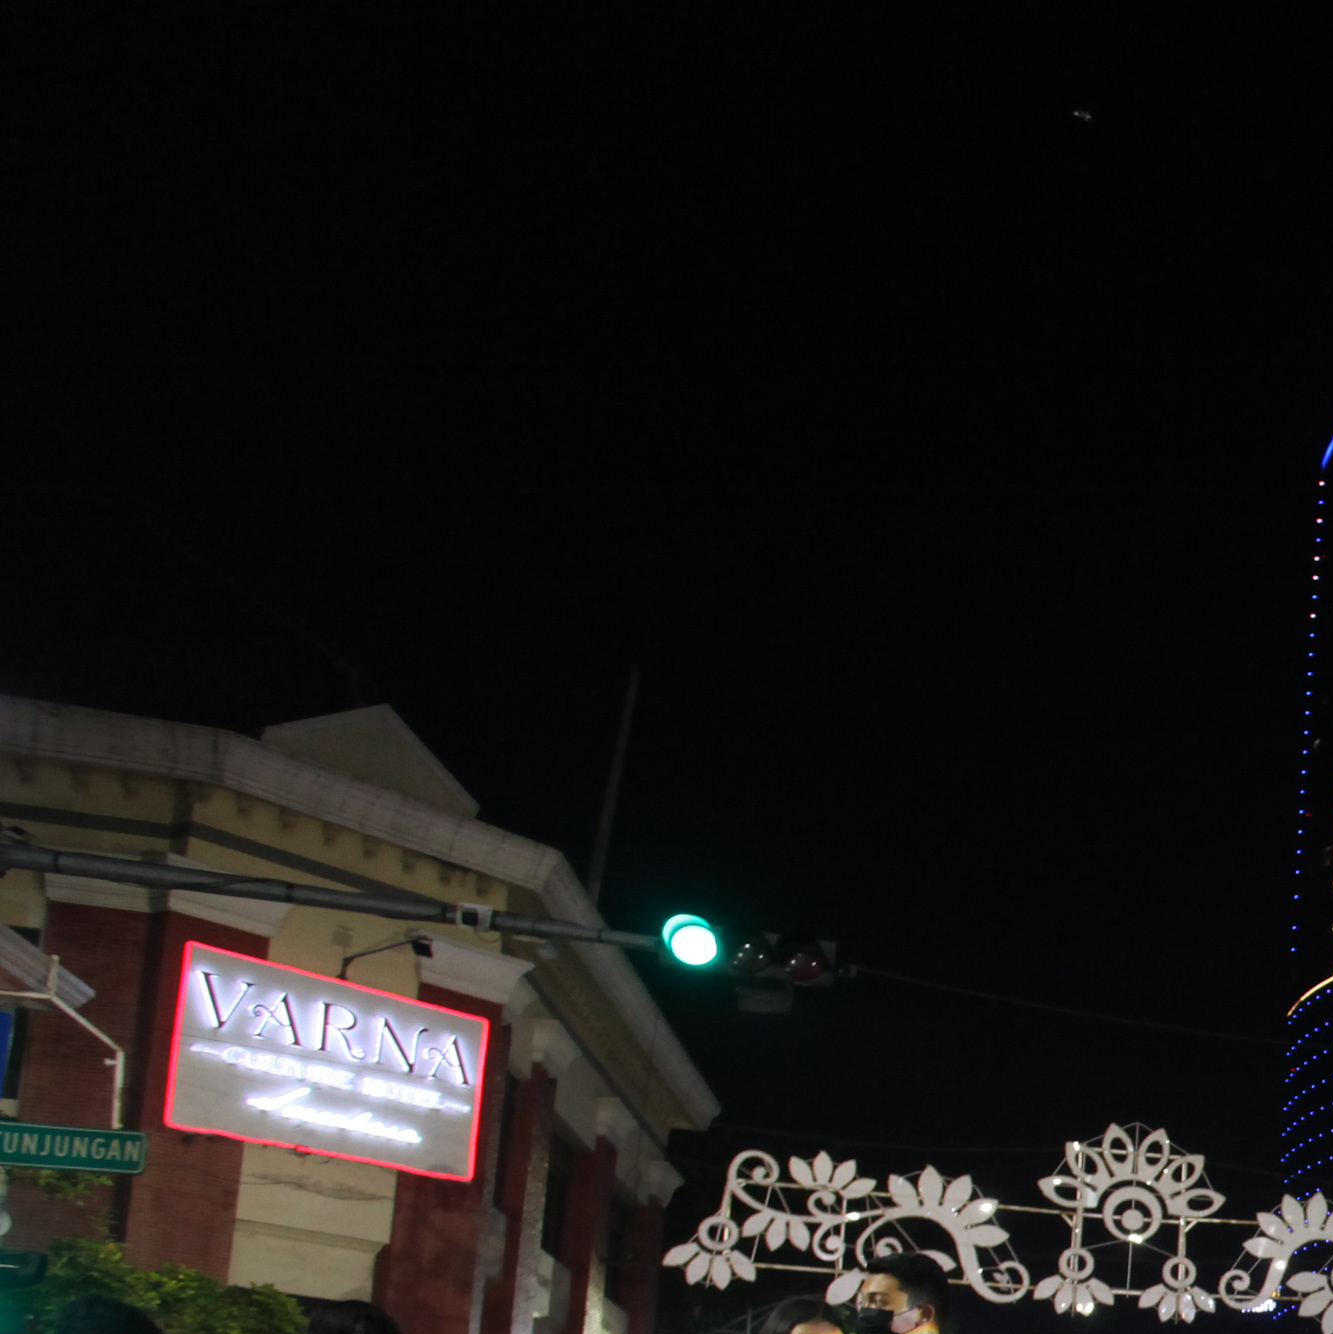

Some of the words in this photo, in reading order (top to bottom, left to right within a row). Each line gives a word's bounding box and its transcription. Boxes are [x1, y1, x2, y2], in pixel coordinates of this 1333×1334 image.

[196, 969, 470, 1086] VARNA
[221, 1046, 355, 1091] CULTURE
[360, 1076, 442, 1110] HOTEL
[0, 1130, 140, 1162] UNJUNGAN
